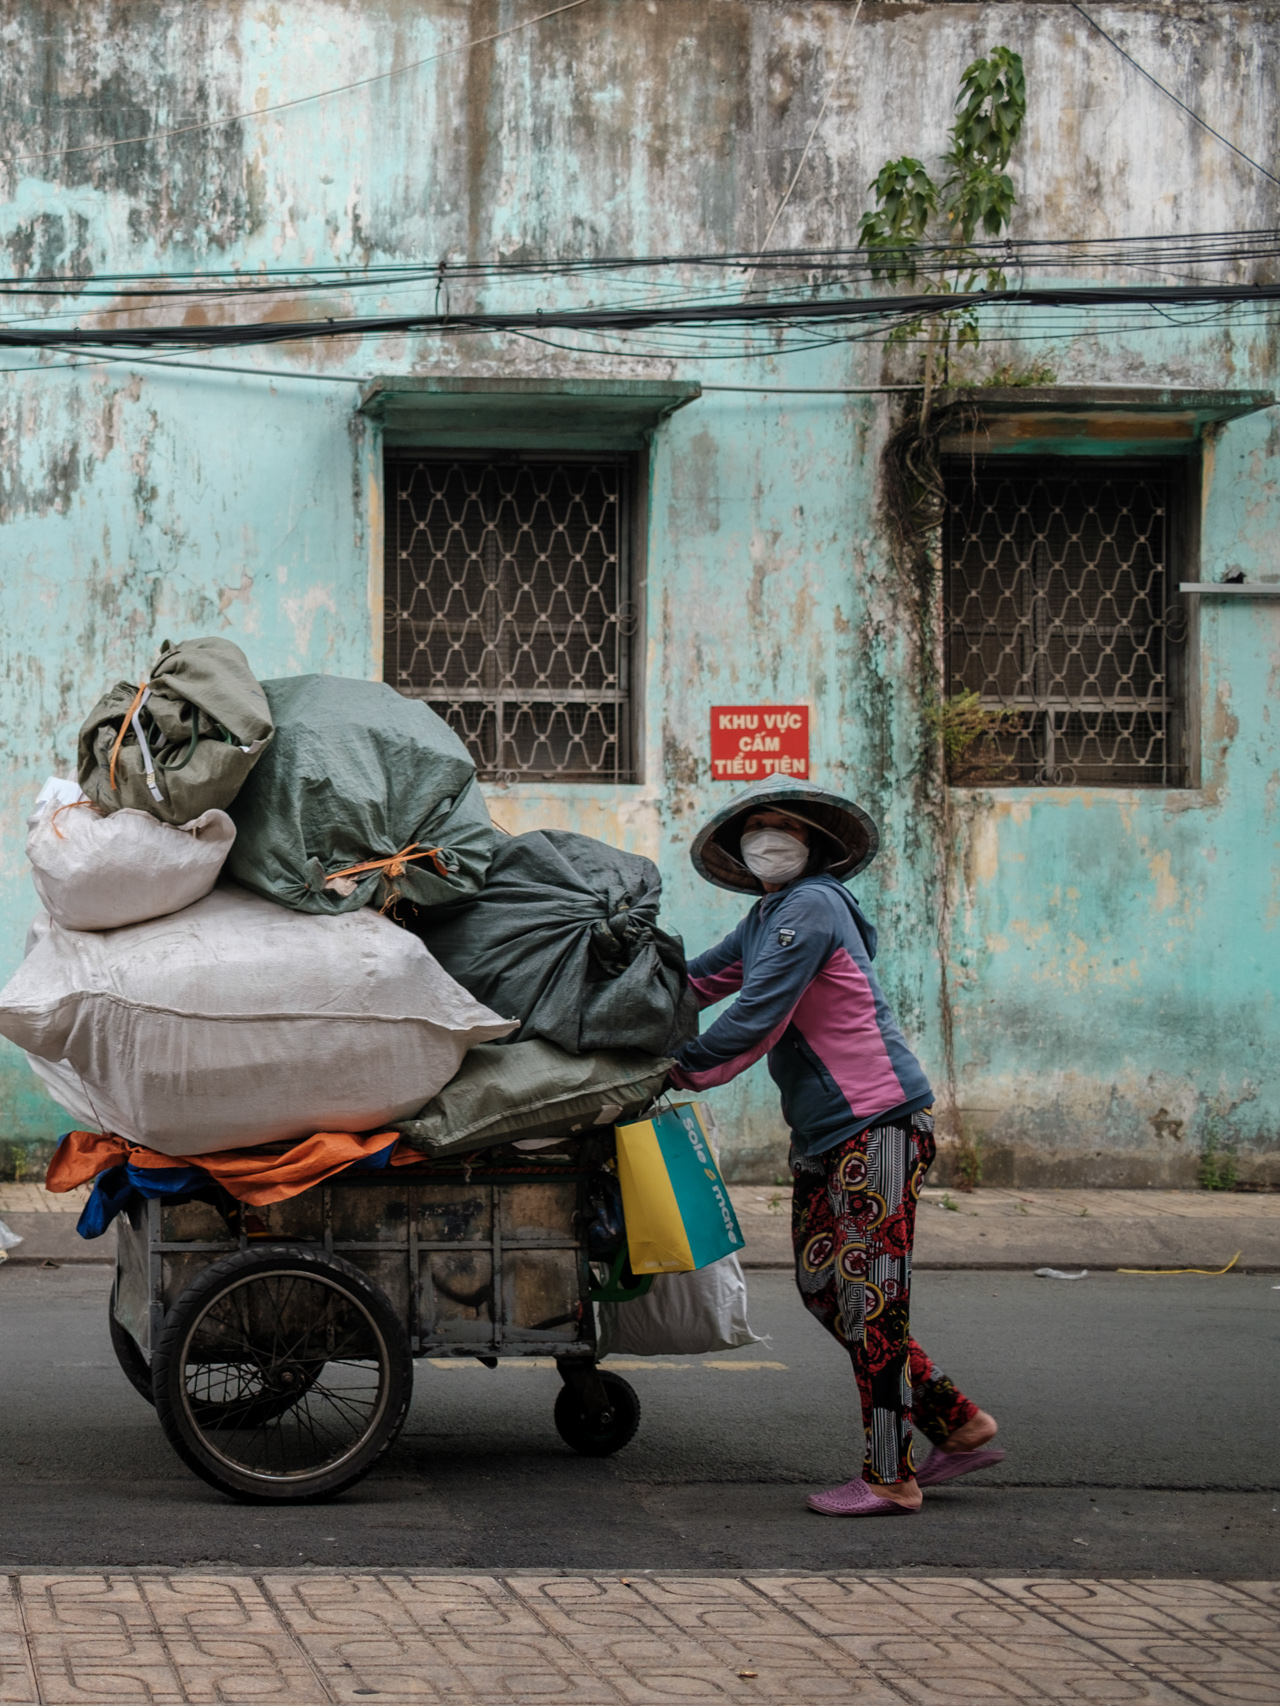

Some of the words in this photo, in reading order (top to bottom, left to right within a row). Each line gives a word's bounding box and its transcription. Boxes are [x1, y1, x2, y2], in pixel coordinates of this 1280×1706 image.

[719, 714, 759, 730] KHU
[763, 711, 802, 733] VỰC
[738, 731, 781, 752] CẤM
[714, 752, 758, 775] TIỂU
[761, 755, 806, 776] TIỆN
[711, 1185, 738, 1245] mate
